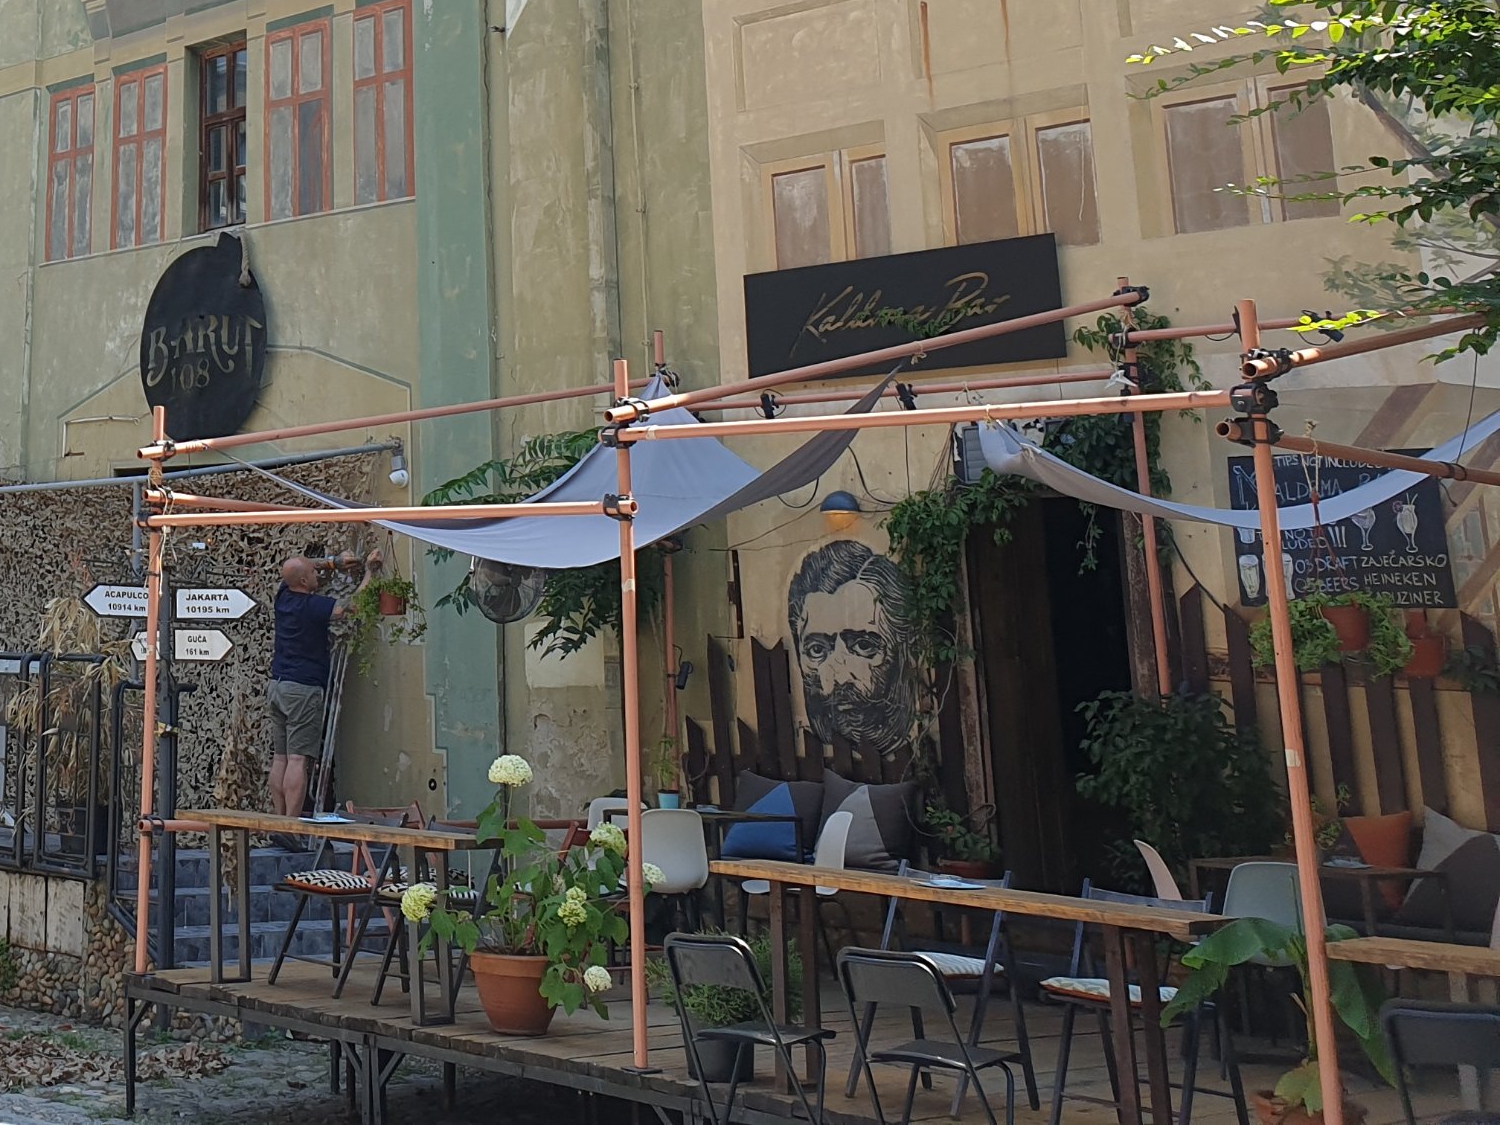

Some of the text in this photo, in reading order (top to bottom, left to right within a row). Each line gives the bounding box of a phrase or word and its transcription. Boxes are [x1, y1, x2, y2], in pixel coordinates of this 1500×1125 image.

[1315, 556, 1357, 572] DRAFT
[1361, 550, 1447, 568] ZAJEČARSKO
[1364, 573, 1437, 586] HEINEKEN
[105, 591, 149, 599] ACAPULCO
[108, 603, 132, 611] 10914
[187, 635, 207, 643] GUČA
